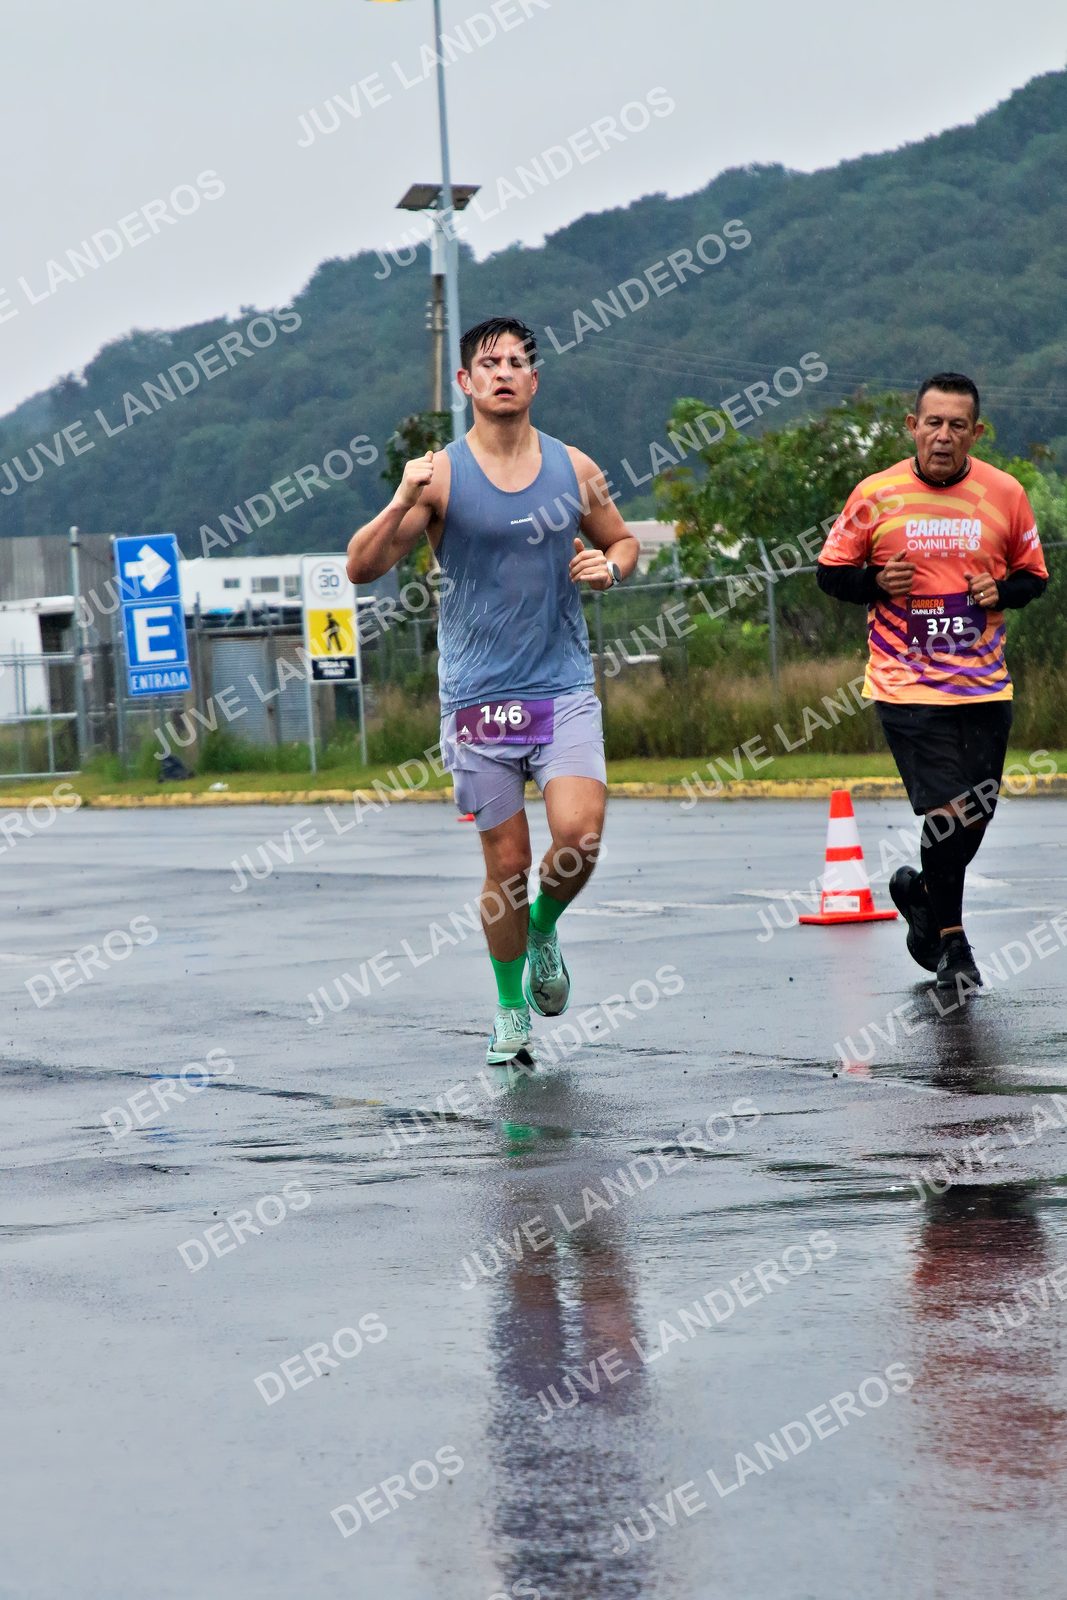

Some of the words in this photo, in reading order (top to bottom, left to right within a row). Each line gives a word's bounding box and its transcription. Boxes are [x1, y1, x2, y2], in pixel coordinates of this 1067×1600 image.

[905, 518, 982, 538] CARRERA
[907, 538, 965, 551] OMNILIFE
[319, 574, 340, 588] 30
[911, 599, 944, 609] CARRERA
[132, 605, 177, 663] E
[926, 616, 964, 636] 373
[131, 671, 188, 690] ENTRADA
[480, 705, 523, 725] 146
